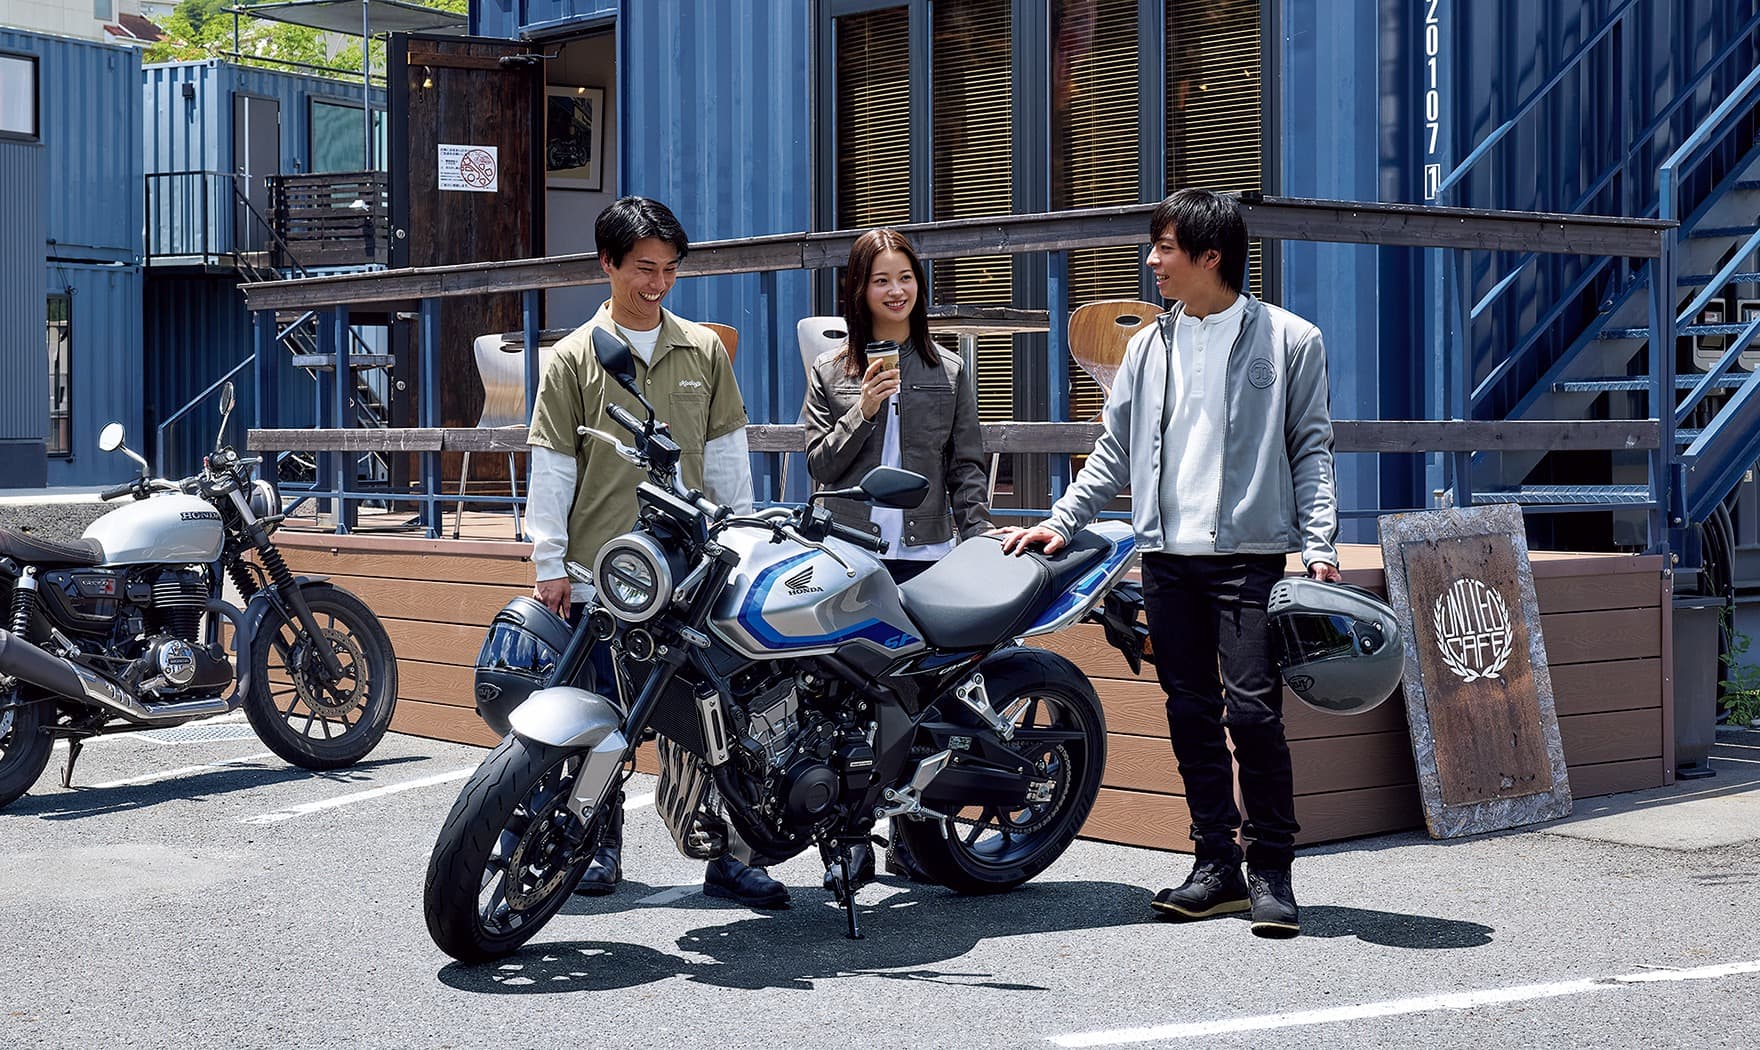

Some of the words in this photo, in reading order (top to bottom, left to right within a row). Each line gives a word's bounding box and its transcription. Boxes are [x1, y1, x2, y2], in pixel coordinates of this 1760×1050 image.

[788, 586, 824, 596] HONDA
[1441, 578, 1505, 638] UNITED
[1446, 631, 1505, 669] CAFE
